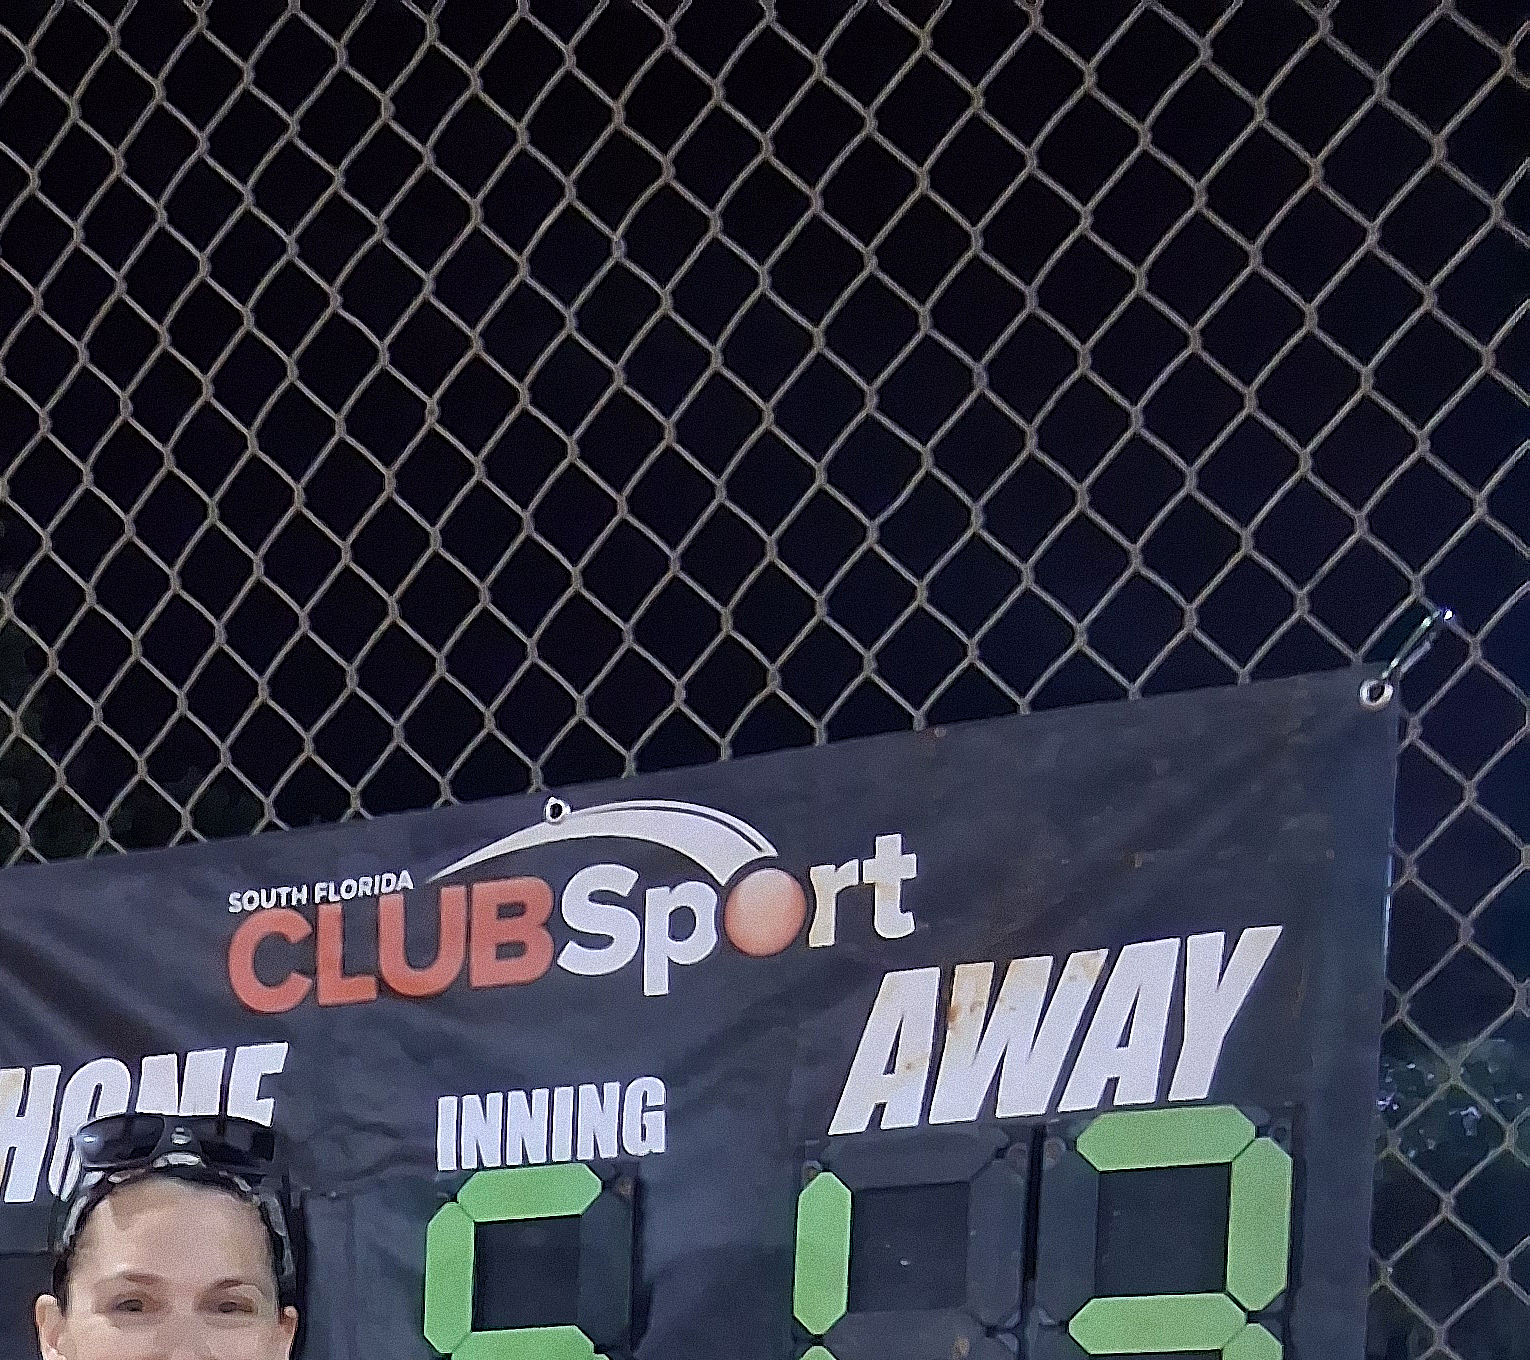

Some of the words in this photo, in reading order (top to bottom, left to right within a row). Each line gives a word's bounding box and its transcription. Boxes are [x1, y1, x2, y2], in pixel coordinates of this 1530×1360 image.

[227, 883, 308, 915] SOUTH
[314, 869, 415, 906] FLORIDA
[827, 925, 1283, 1136] AWAY
[435, 1076, 669, 1172] INNING
